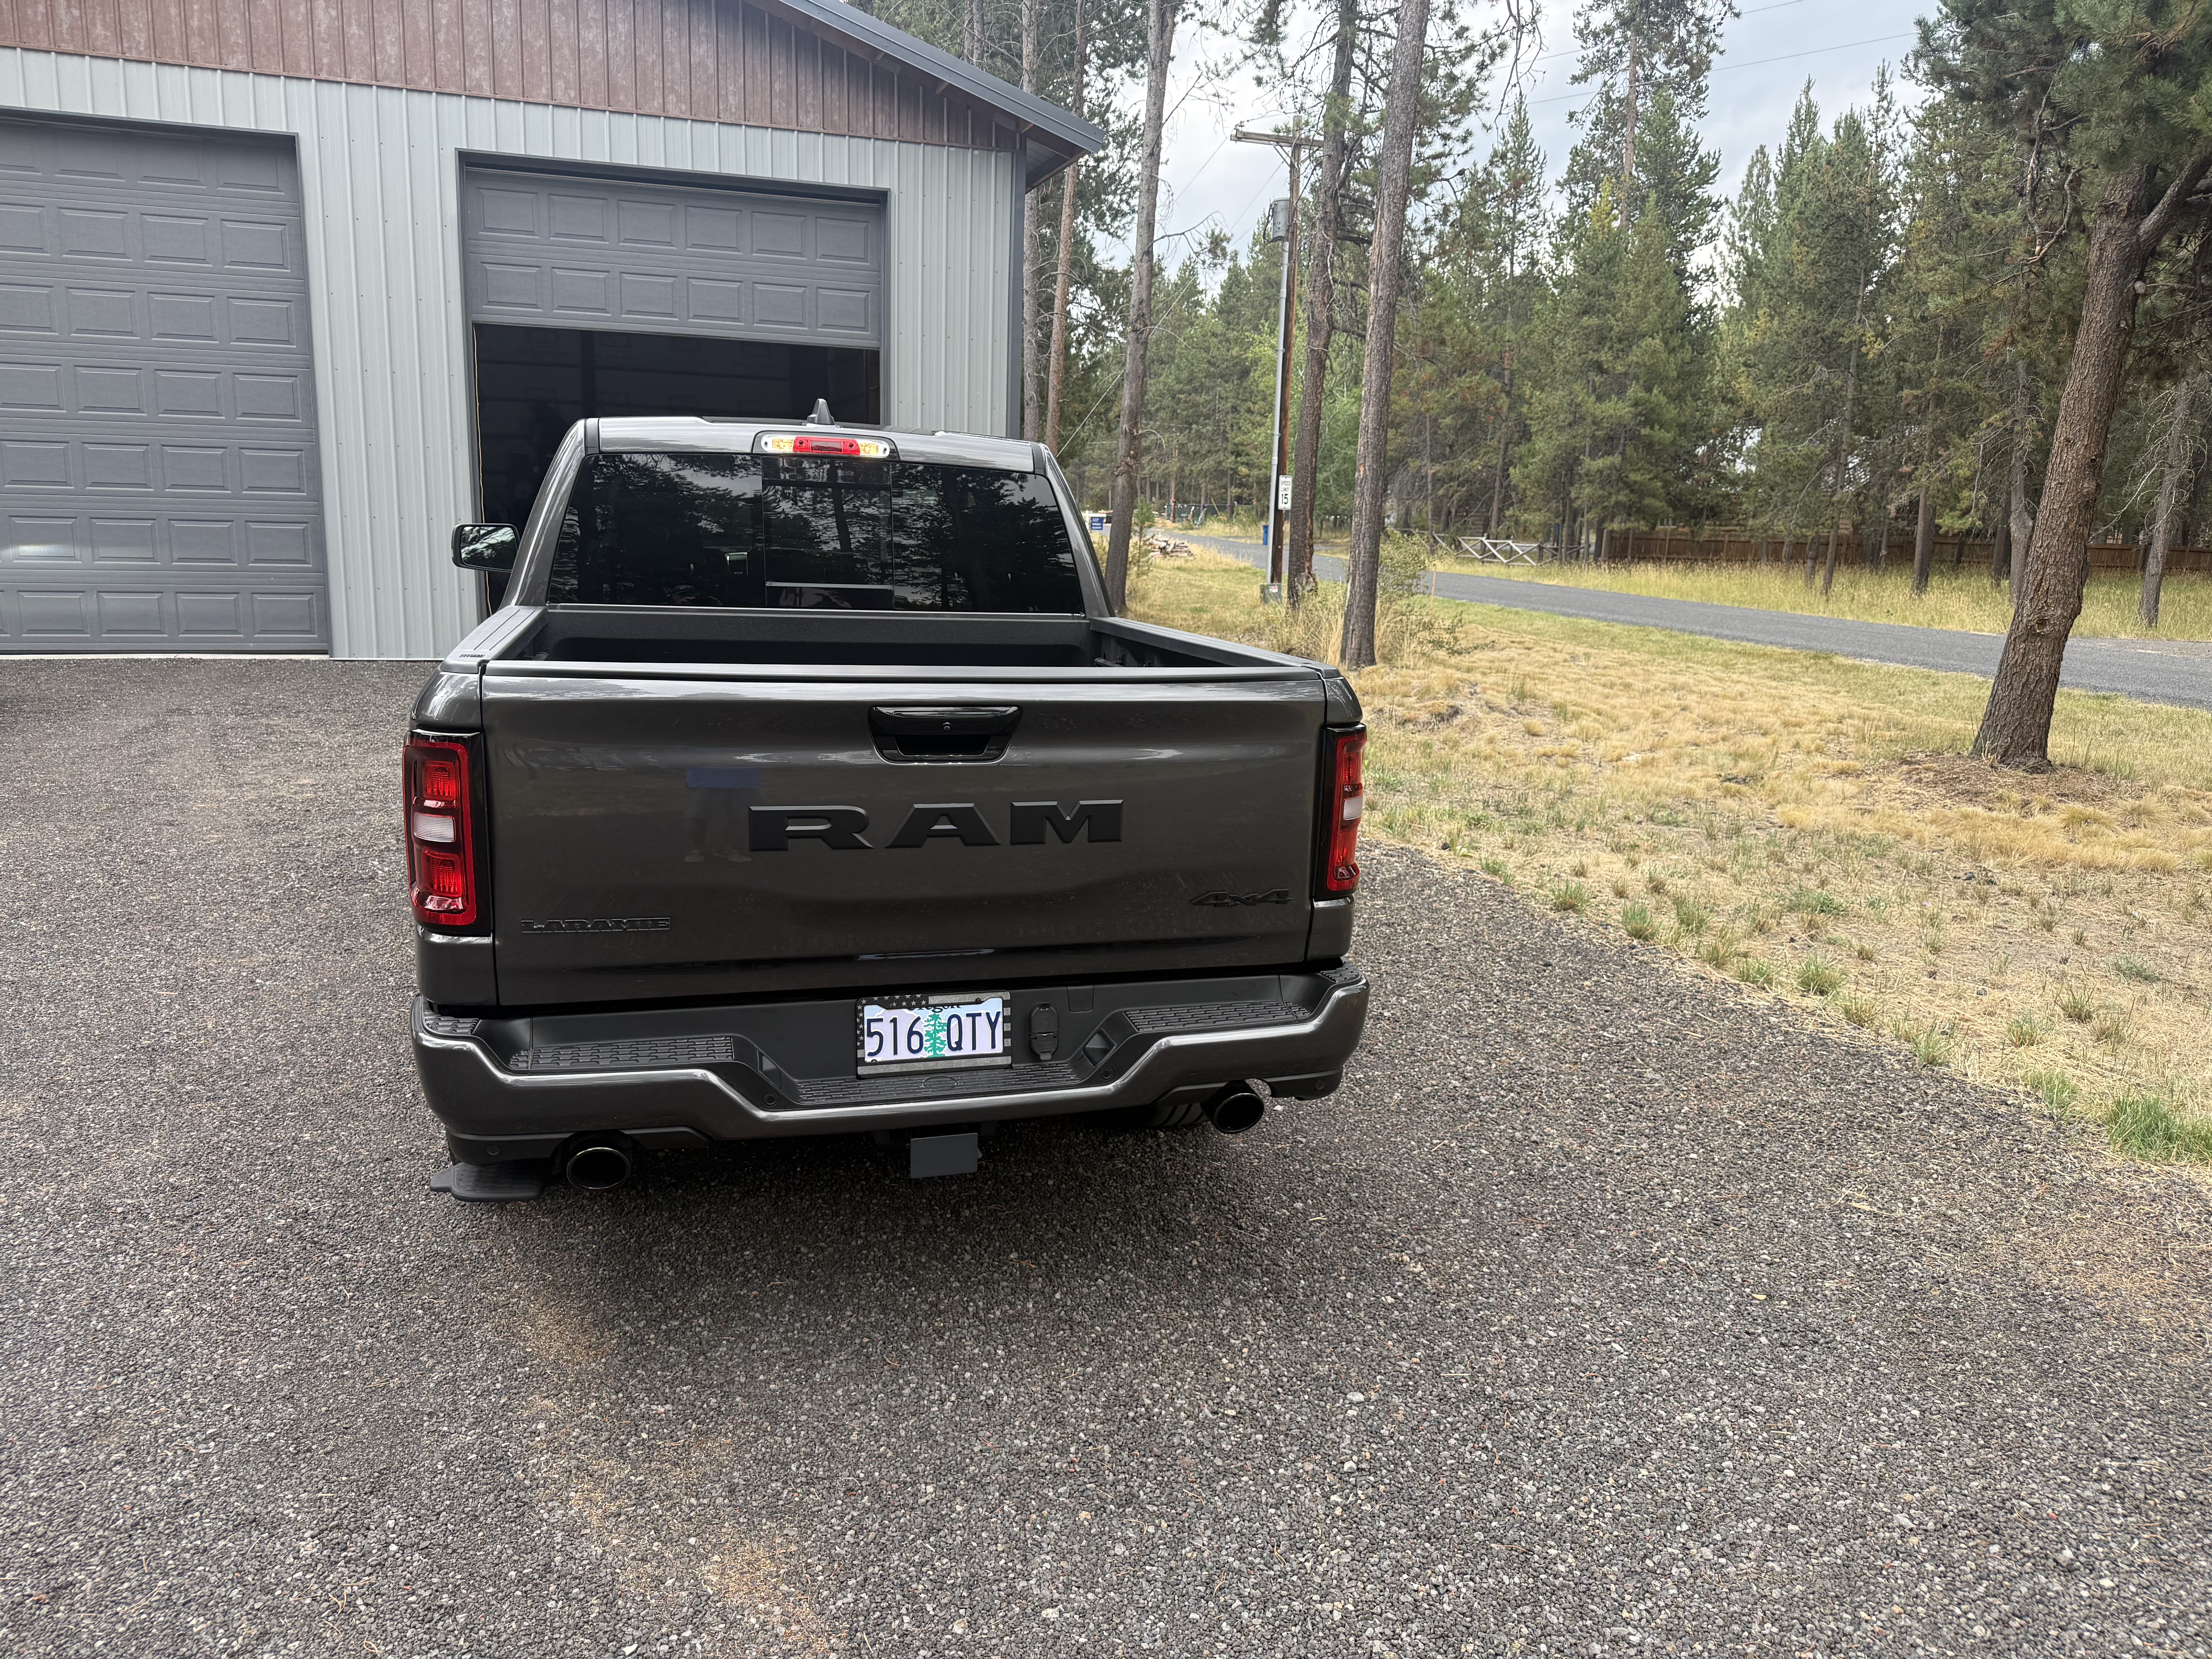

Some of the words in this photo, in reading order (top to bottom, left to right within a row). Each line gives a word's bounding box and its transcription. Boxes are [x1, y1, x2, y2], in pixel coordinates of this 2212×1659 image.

[1282, 493, 1288, 504] 15
[748, 799, 1123, 851] RAM
[520, 917, 671, 933] LARAMIE
[867, 1016, 924, 1056] 516
[946, 1011, 1001, 1051] QTY
